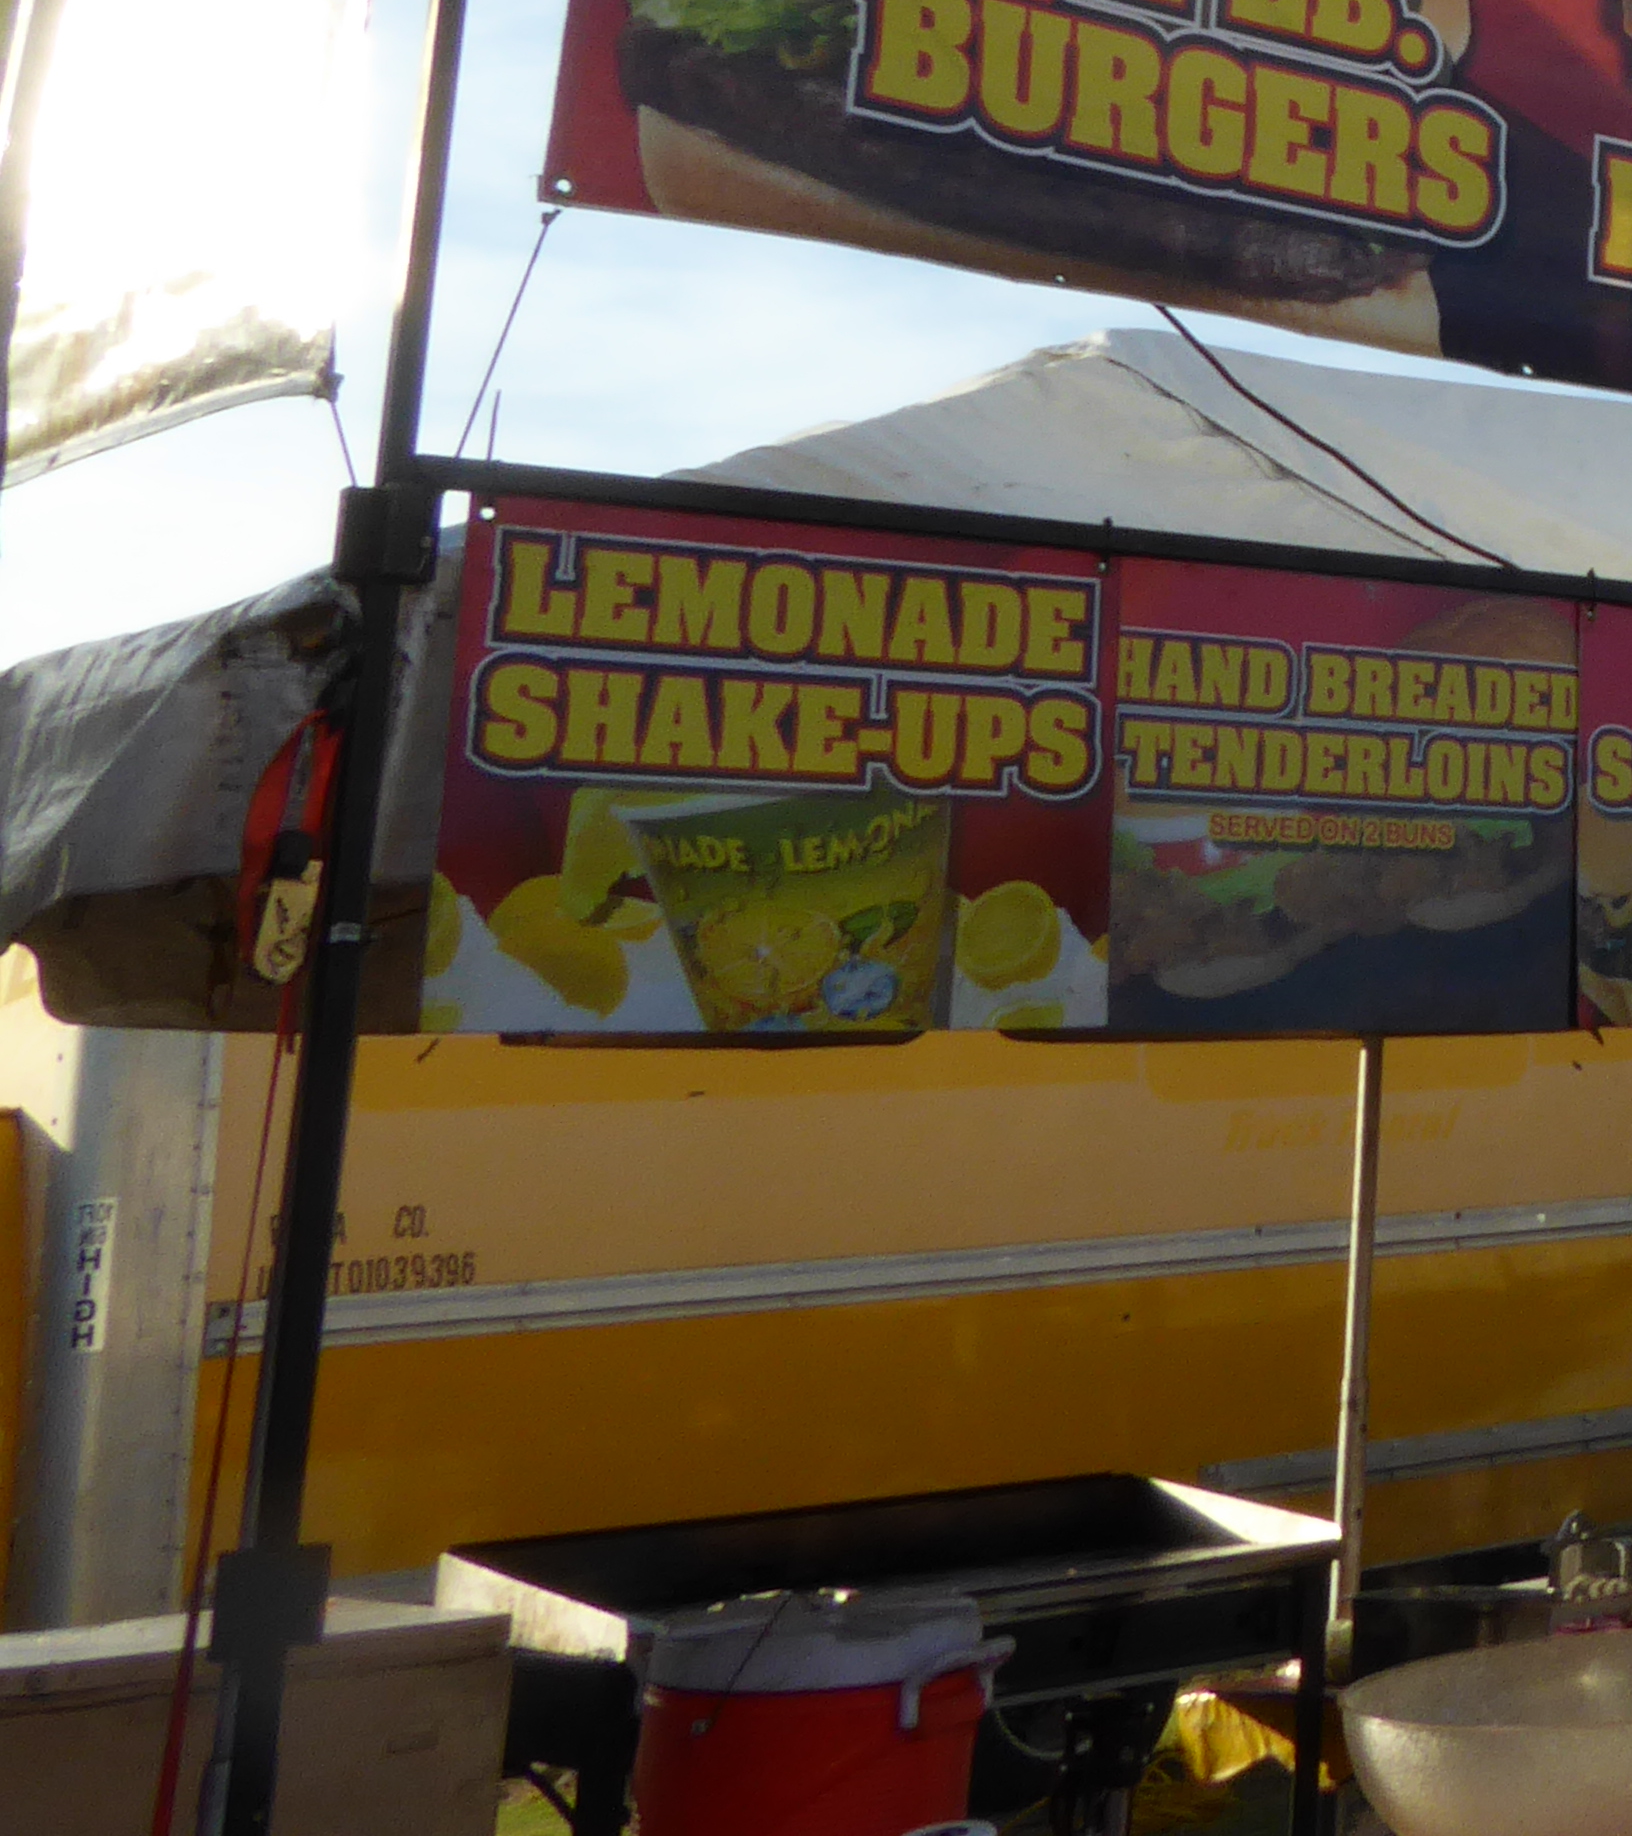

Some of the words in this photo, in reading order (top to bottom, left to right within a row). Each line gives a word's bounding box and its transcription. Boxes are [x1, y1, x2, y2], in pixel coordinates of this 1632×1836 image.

[504, 541, 1089, 675] LEMONADE
[479, 661, 1091, 790] SHAKE-UPS
[1117, 635, 1288, 711] HAND
[1309, 650, 1579, 732] BREADED
[1121, 719, 1567, 807] TENDERLOINS
[1208, 812, 1314, 845] SERVED
[1318, 816, 1359, 846] ON
[1363, 820, 1382, 847] 2
[1385, 821, 1455, 851] BUNS
